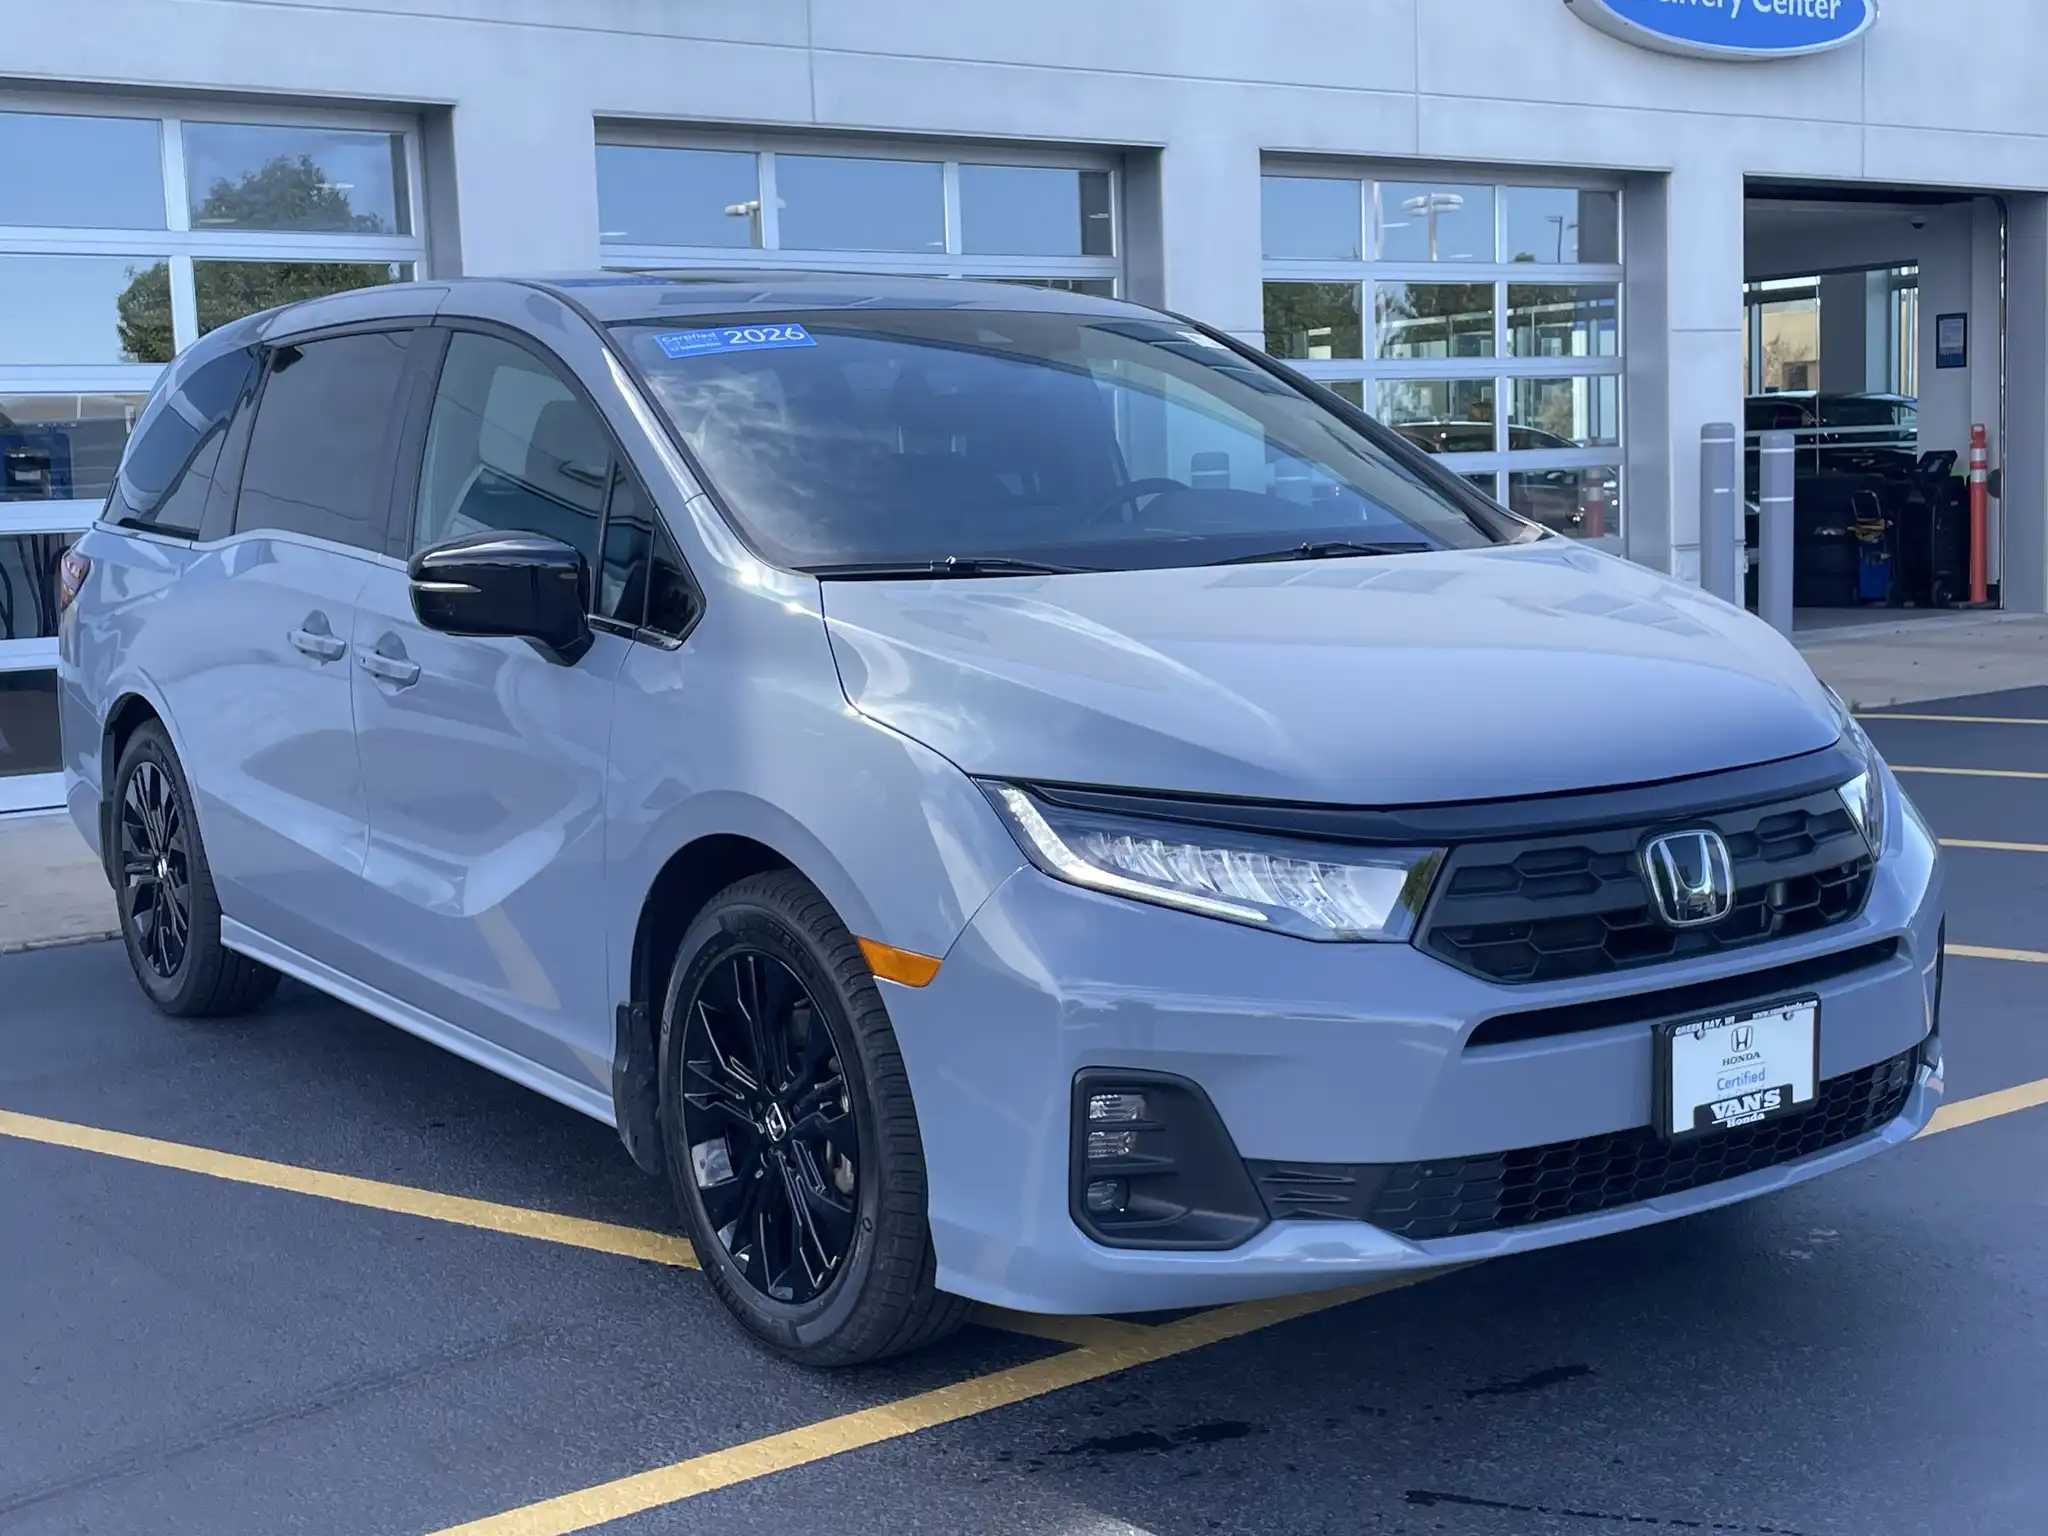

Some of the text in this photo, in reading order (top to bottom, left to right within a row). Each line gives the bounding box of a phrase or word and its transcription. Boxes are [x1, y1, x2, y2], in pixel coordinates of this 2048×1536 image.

[723, 327, 805, 345] 2026
[1675, 1021, 1703, 1036] GREEN
[1722, 1051, 1761, 1067] HONDA
[1716, 1067, 1767, 1091] Certified
[1726, 1111, 1766, 1128] Honda
